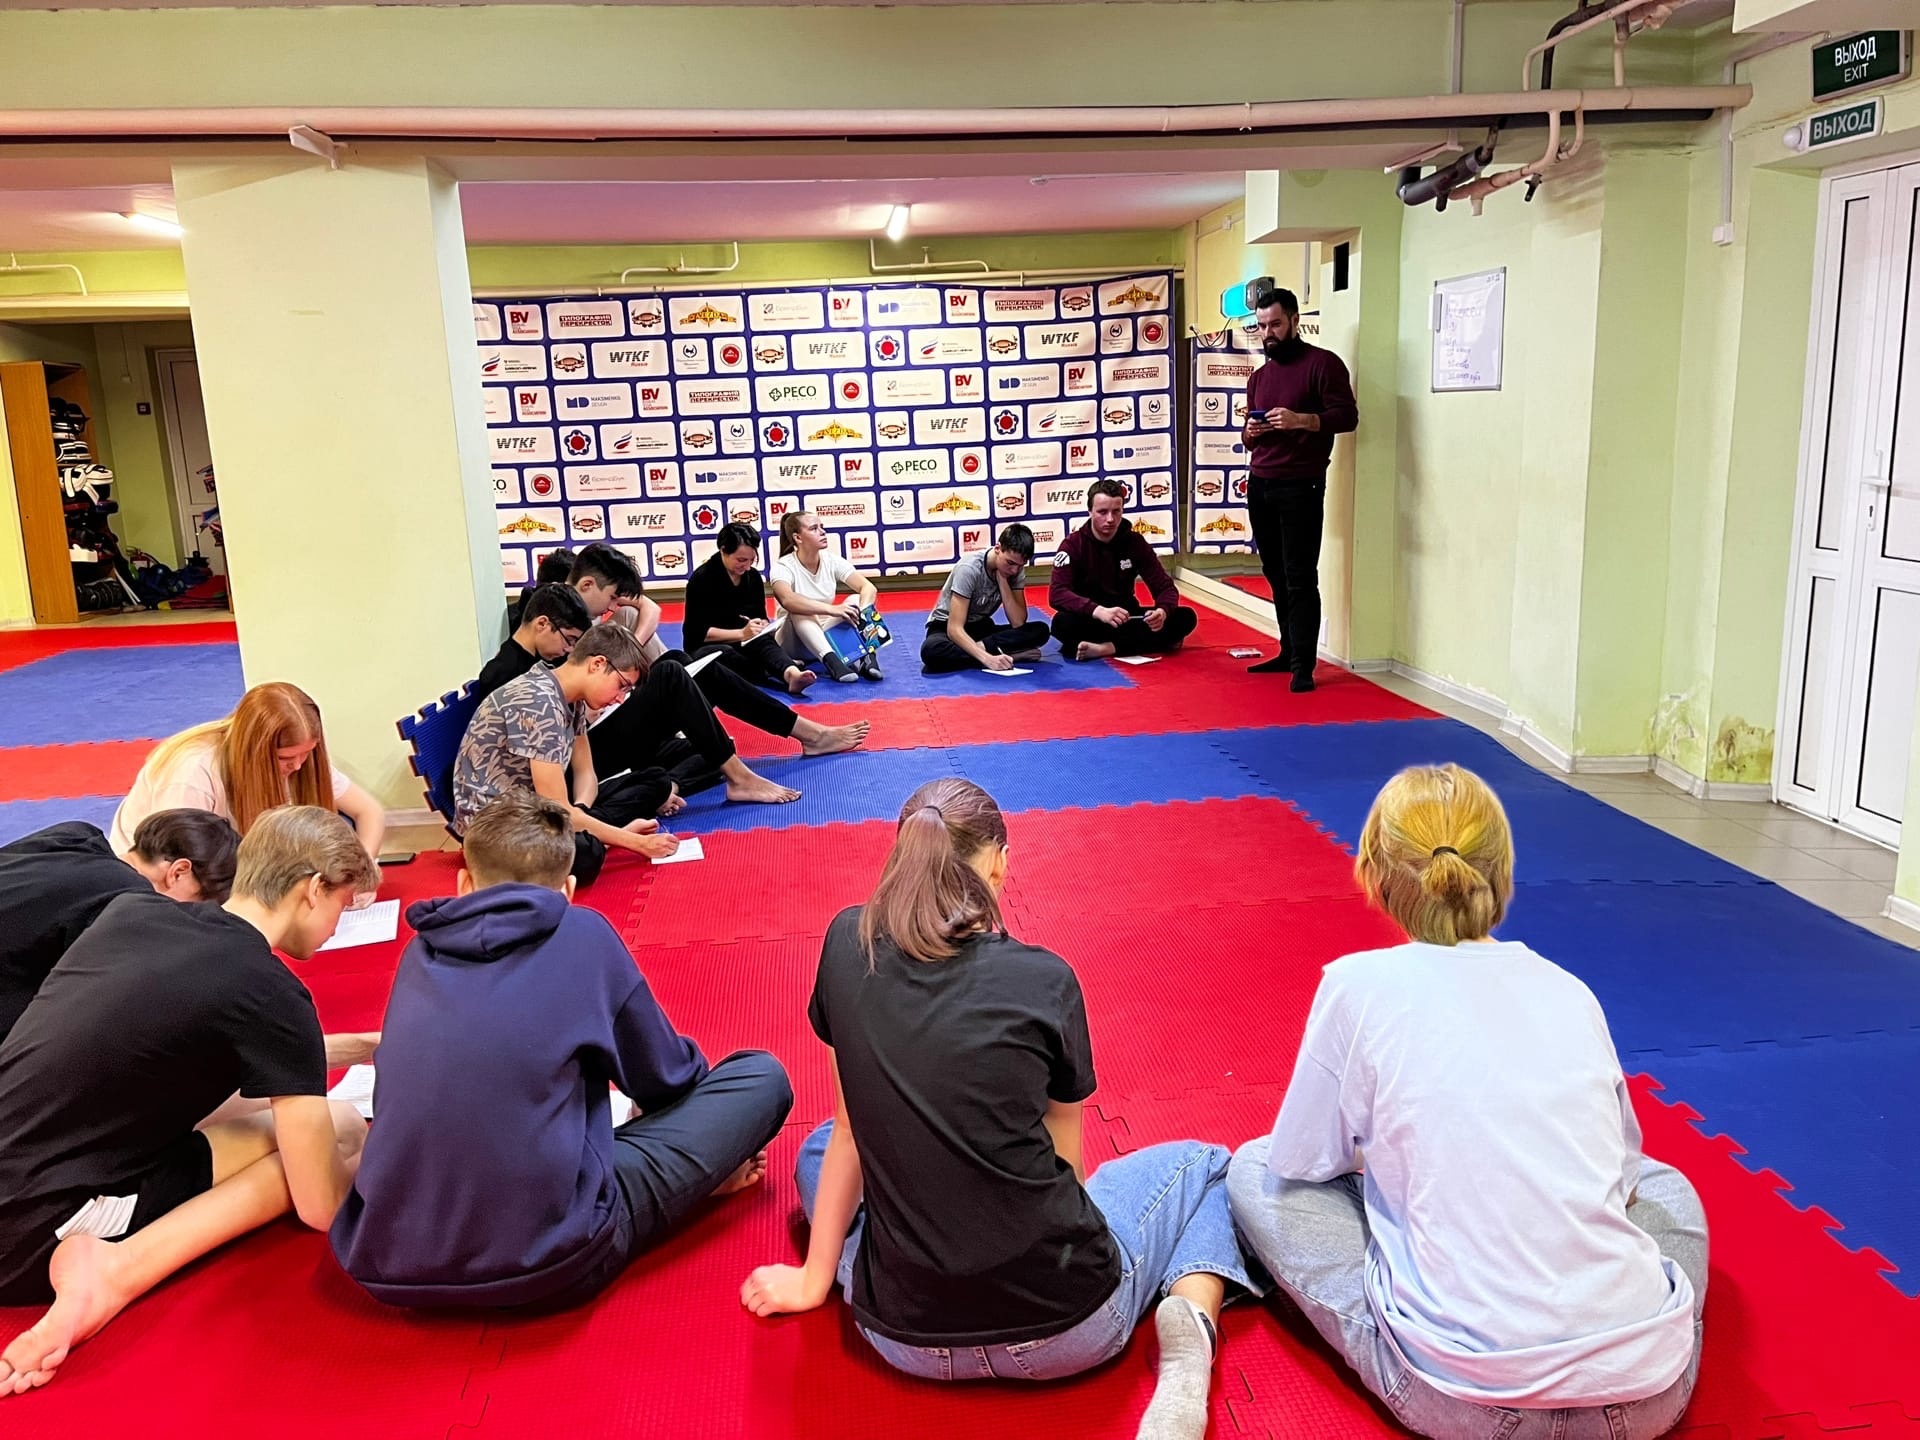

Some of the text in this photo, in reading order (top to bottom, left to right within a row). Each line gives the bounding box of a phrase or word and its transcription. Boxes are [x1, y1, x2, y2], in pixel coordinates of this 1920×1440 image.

[1834, 35, 1877, 66] ВЫХОД
[1844, 62, 1869, 83] EXIT
[1813, 108, 1872, 140] ВЫХОД
[833, 298, 851, 310] BV
[950, 295, 967, 307] BV
[510, 311, 529, 324] BV
[1041, 332, 1080, 345] WTKF
[808, 342, 848, 355] WTKF
[609, 350, 650, 363] WTKF
[1068, 367, 1086, 380] BV
[955, 374, 973, 387] BV
[519, 393, 538, 405] BV
[641, 388, 660, 400] BV
[930, 417, 969, 430] WTKF
[496, 437, 537, 449] WTKF
[1071, 445, 1088, 458] BV
[778, 464, 819, 477] WTKF
[844, 459, 863, 471] BV
[650, 468, 668, 481] BV
[1047, 489, 1085, 502] WTKF
[770, 502, 788, 514] BV
[626, 514, 667, 527] WTKF
[850, 537, 868, 549] BV
[963, 531, 981, 543] BV
